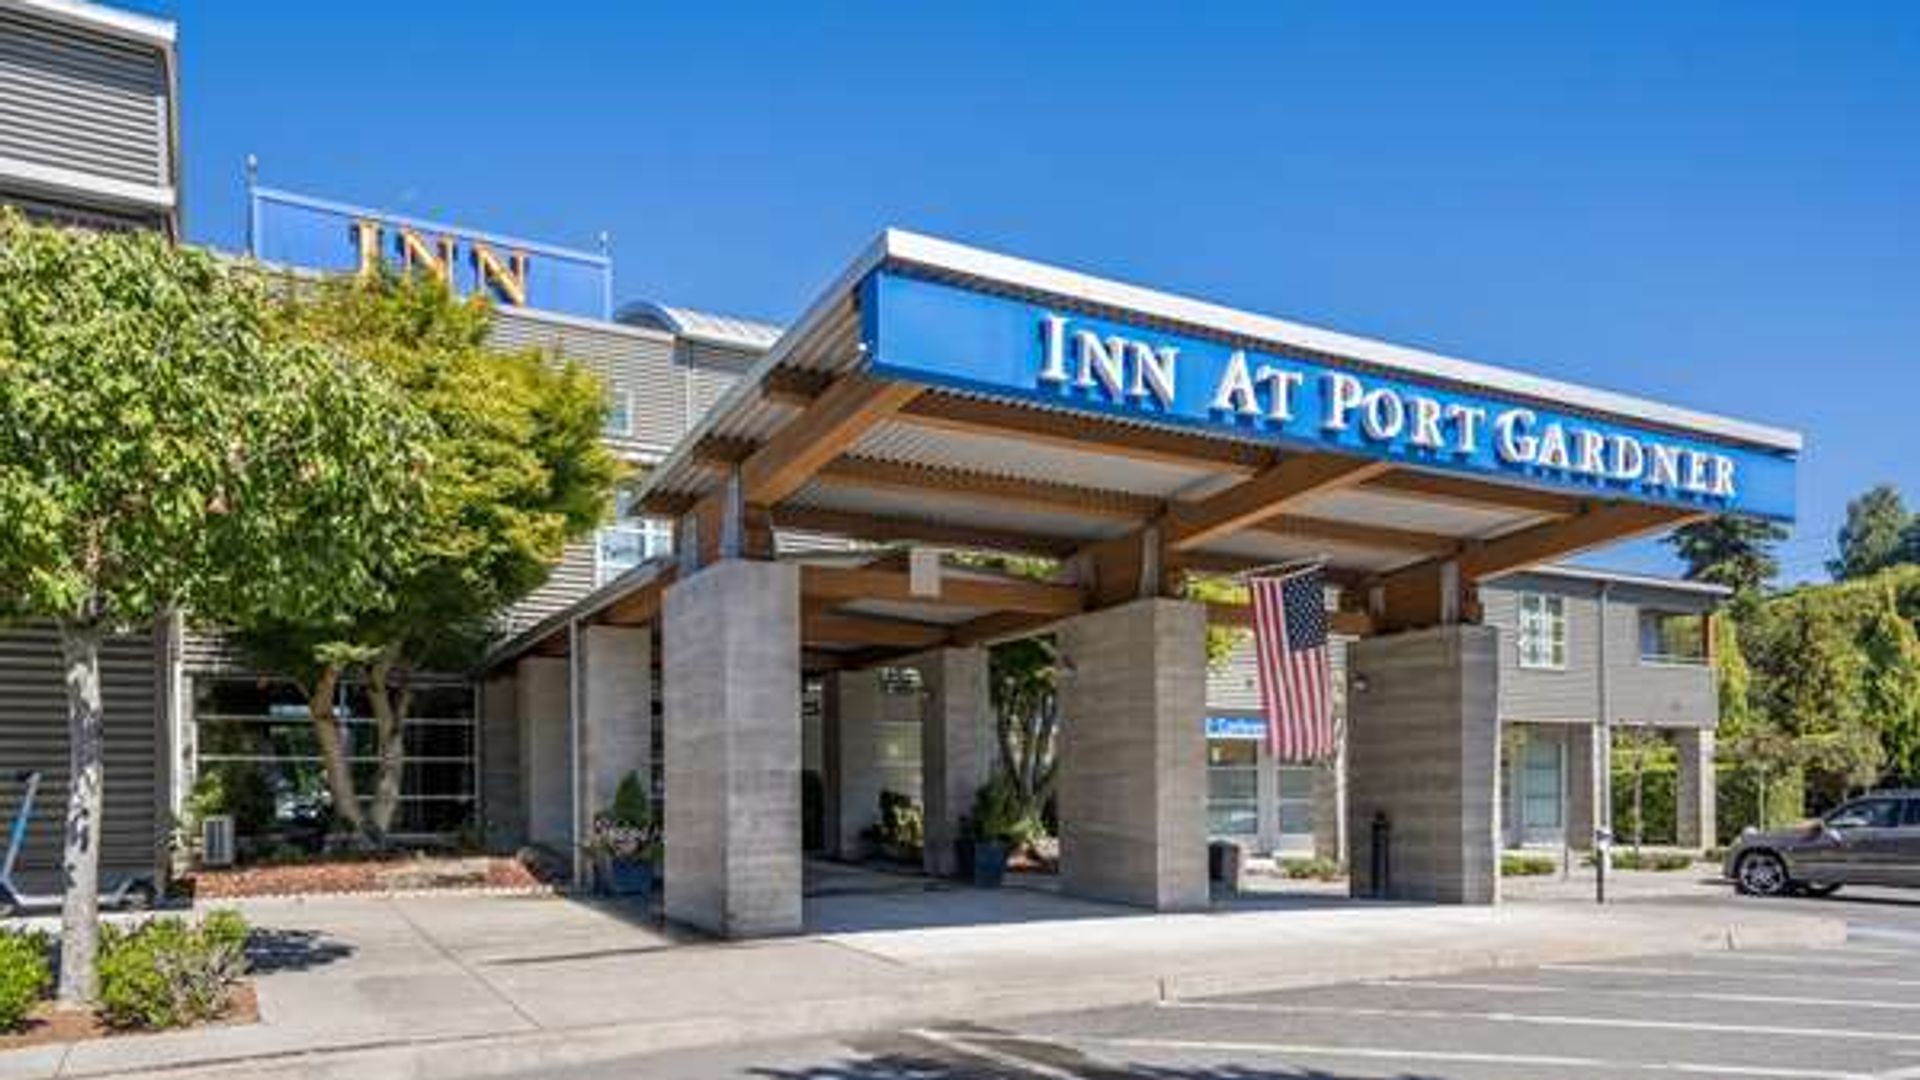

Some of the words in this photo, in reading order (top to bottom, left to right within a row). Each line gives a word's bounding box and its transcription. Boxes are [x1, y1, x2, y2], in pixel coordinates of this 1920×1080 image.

[355, 219, 529, 306] INN
[1038, 312, 1180, 412] INN
[1208, 349, 1303, 421] AT
[1322, 370, 1487, 453] PORT
[1498, 408, 1736, 497] GARDNER
